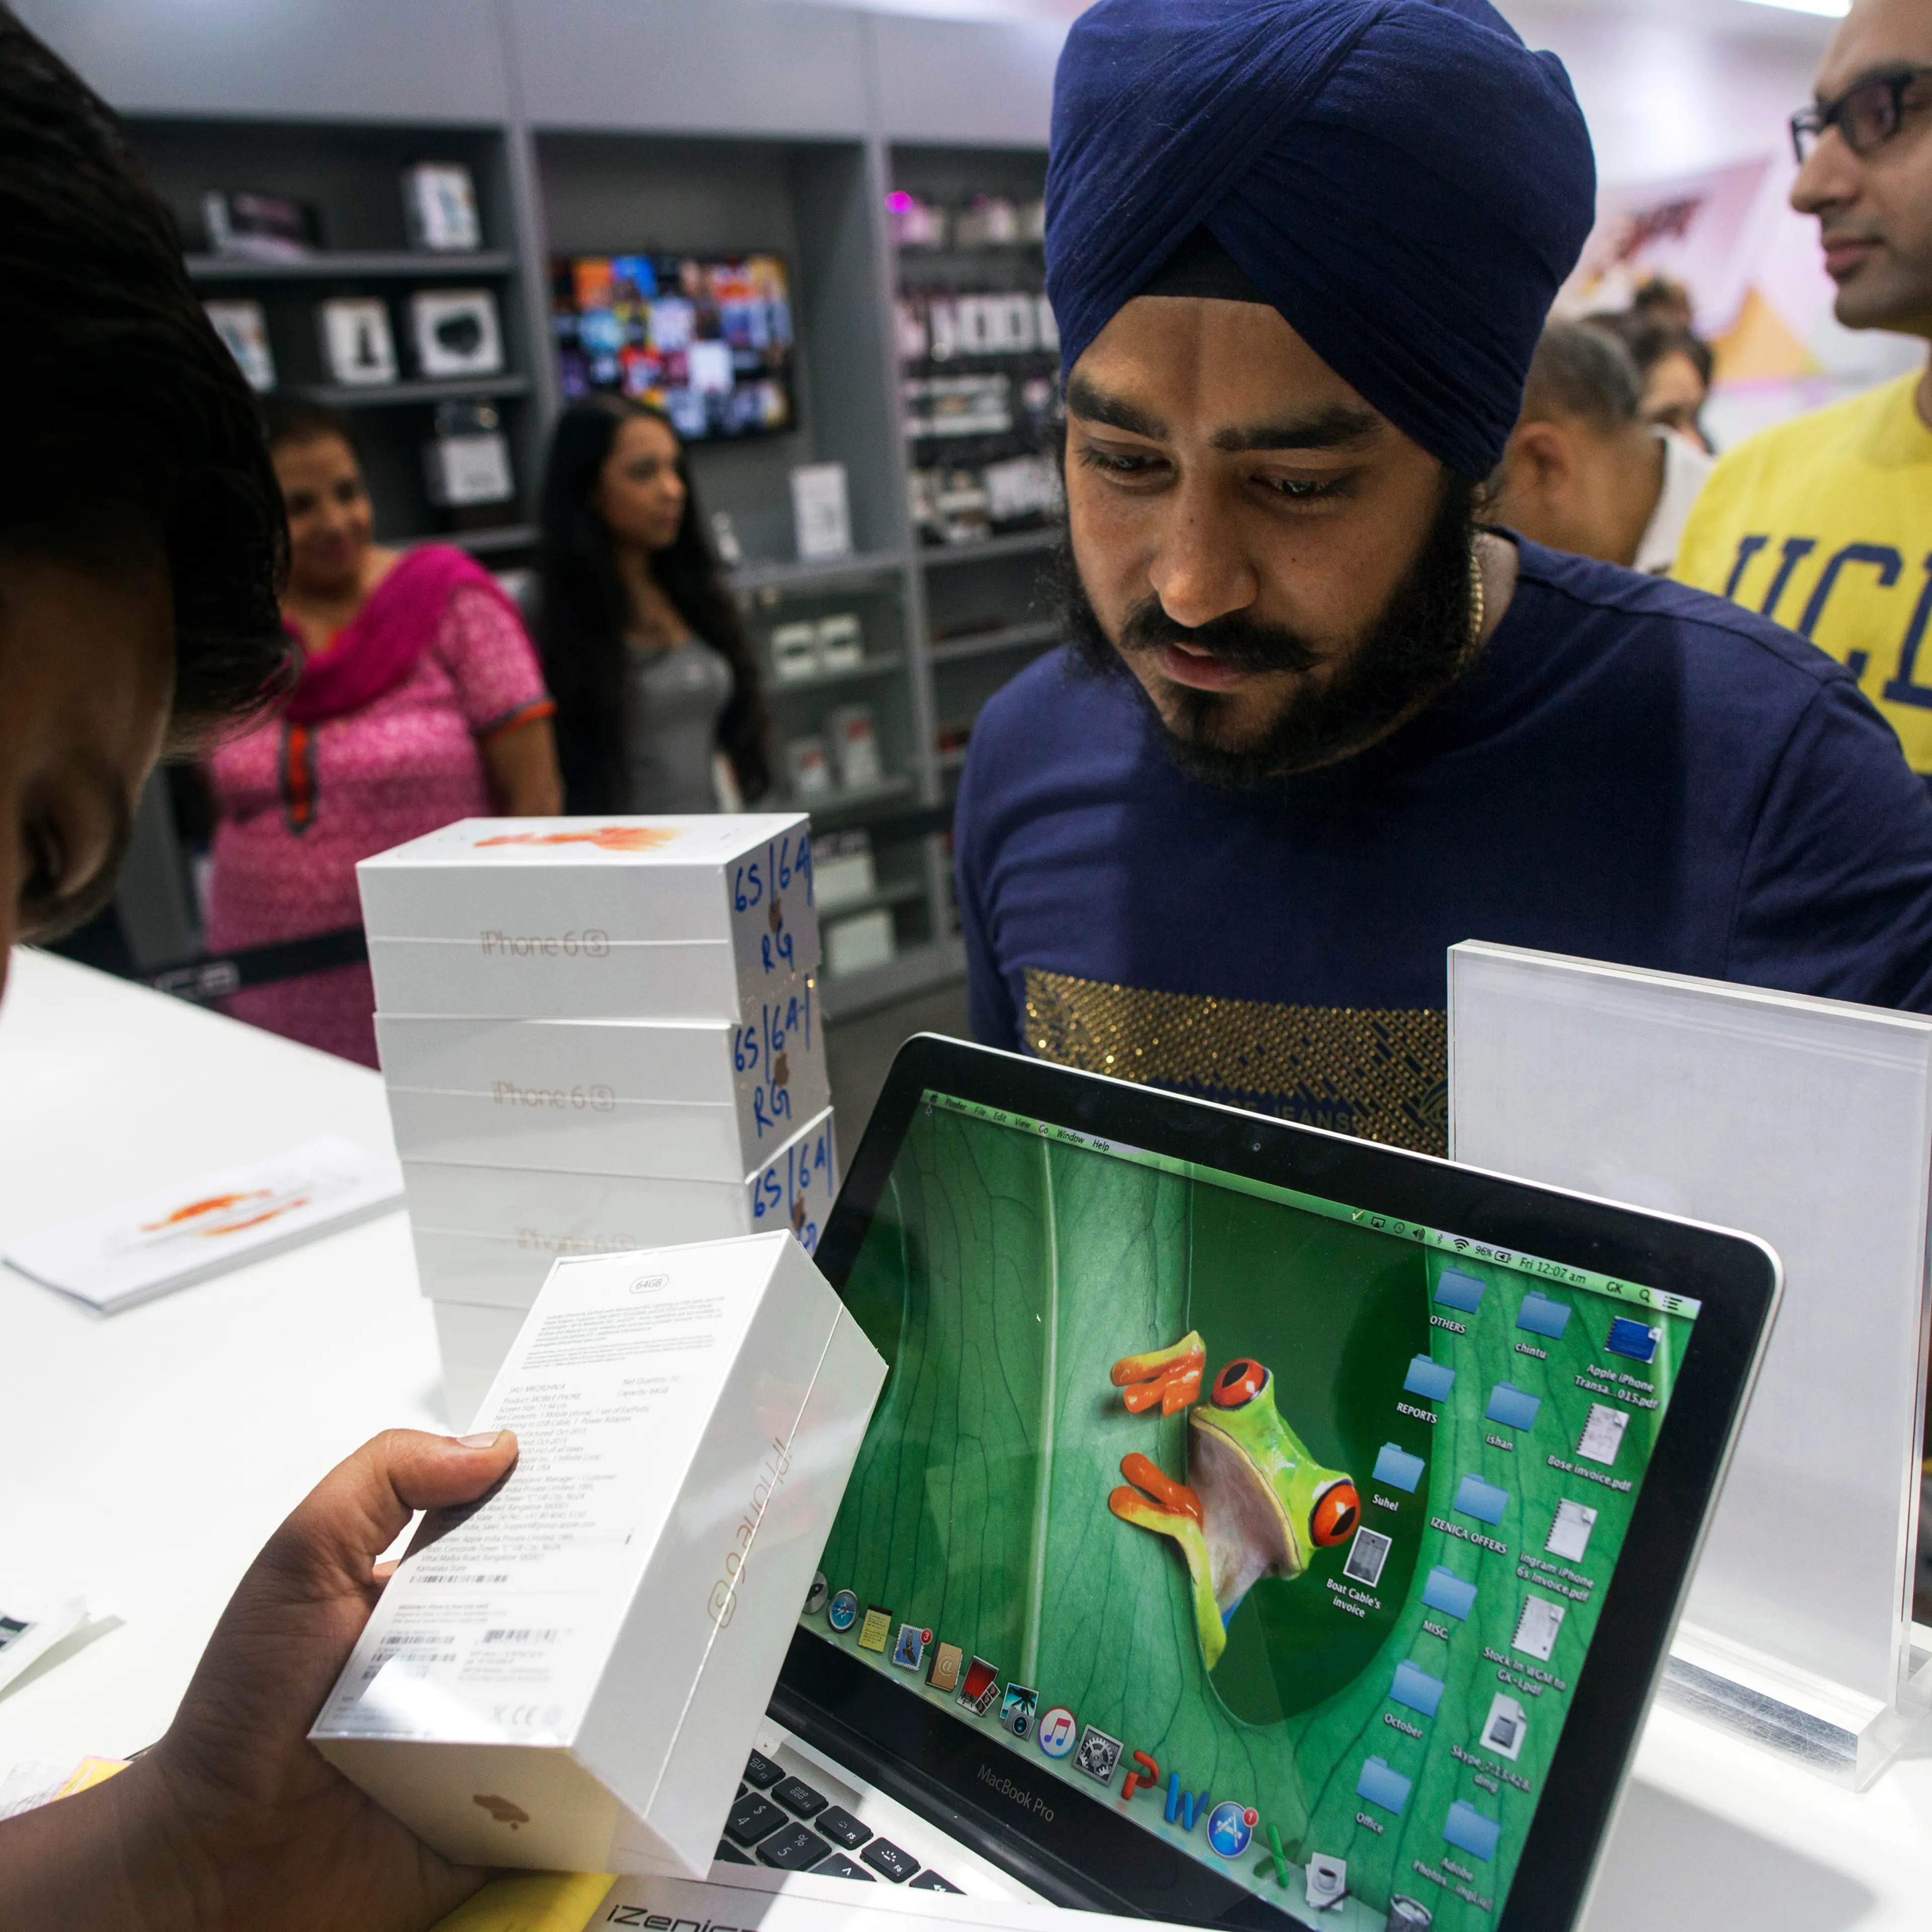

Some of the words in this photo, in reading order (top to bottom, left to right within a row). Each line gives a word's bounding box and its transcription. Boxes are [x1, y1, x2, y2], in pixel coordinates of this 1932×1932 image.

[480, 929, 559, 956] iPhone
[491, 1081, 565, 1108] iPhone
[945, 1098, 967, 1111] Finder
[974, 1106, 987, 1116] File
[993, 1111, 1007, 1122] Edit
[1015, 1117, 1031, 1130] View
[1038, 1124, 1049, 1135] Go
[1057, 1129, 1085, 1144] Window
[1092, 1139, 1110, 1152] Help
[1475, 1245, 1492, 1257] 96%
[1519, 1257, 1534, 1269] Fri
[1536, 1261, 1567, 1278] 12:07
[1569, 1272, 1586, 1284] am
[1605, 1281, 1624, 1295] GK
[635, 1278, 663, 1290] 64GB
[1429, 1315, 1467, 1334] OTHERS
[1514, 1342, 1547, 1358] chintu
[1586, 1364, 1618, 1382] Apple
[1618, 1373, 1655, 1393] iPhone
[1396, 1402, 1438, 1424] REPORTS
[1486, 1433, 1513, 1451] ishan
[1547, 1455, 1572, 1472] Bose
[1373, 1494, 1399, 1511] Suhel
[1430, 1516, 1468, 1540] IZENICA
[1470, 1533, 1508, 1555] OFFERS
[1326, 1578, 1347, 1595] Boat
[1348, 1588, 1381, 1610] Cable's
[1332, 1595, 1365, 1619] invoice
[1384, 1712, 1423, 1739] October
[977, 1764, 1032, 1809] MacBook
[1032, 1797, 1055, 1821] Pro
[738, 1816, 751, 1826] 4
[777, 1846, 792, 1857] 5
[794, 1834, 809, 1846] %
[893, 1864, 903, 1873] F6
[606, 1904, 760, 1932] iZeni
